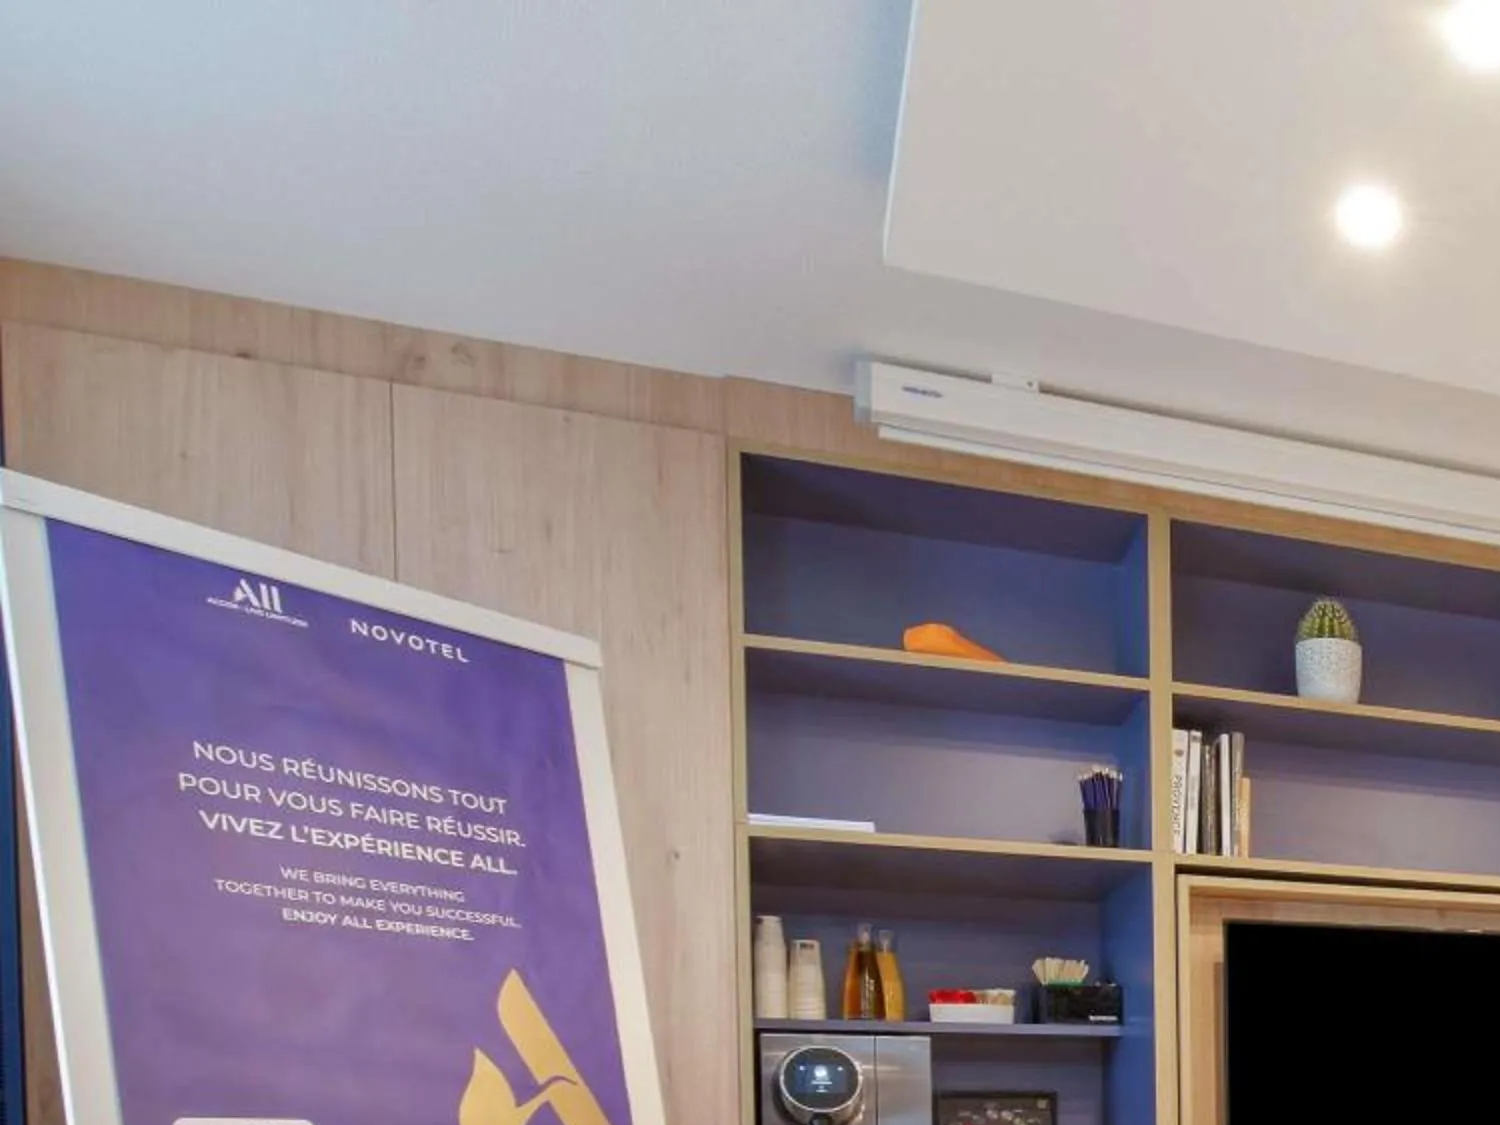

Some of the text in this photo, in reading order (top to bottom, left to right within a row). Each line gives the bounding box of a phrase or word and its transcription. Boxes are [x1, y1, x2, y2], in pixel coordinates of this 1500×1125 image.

[351, 619, 470, 663] NOVOTEL
[193, 740, 507, 814] NOUS RÉUNISSONS TOUT
[178, 772, 526, 848] POUR VOUS FAIRE RÉUSSIR.
[199, 809, 284, 840] VIVEZ
[290, 825, 465, 867] L'EXPÉRIENCE
[215, 878, 309, 902] TOGETHER
[312, 891, 336, 905] TO
[340, 895, 385, 911] MAKE
[390, 900, 423, 916] YOU
[280, 864, 465, 903] WE BRING EVERYTHING
[282, 907, 337, 925] ENJOY
[341, 914, 373, 929] ALL
